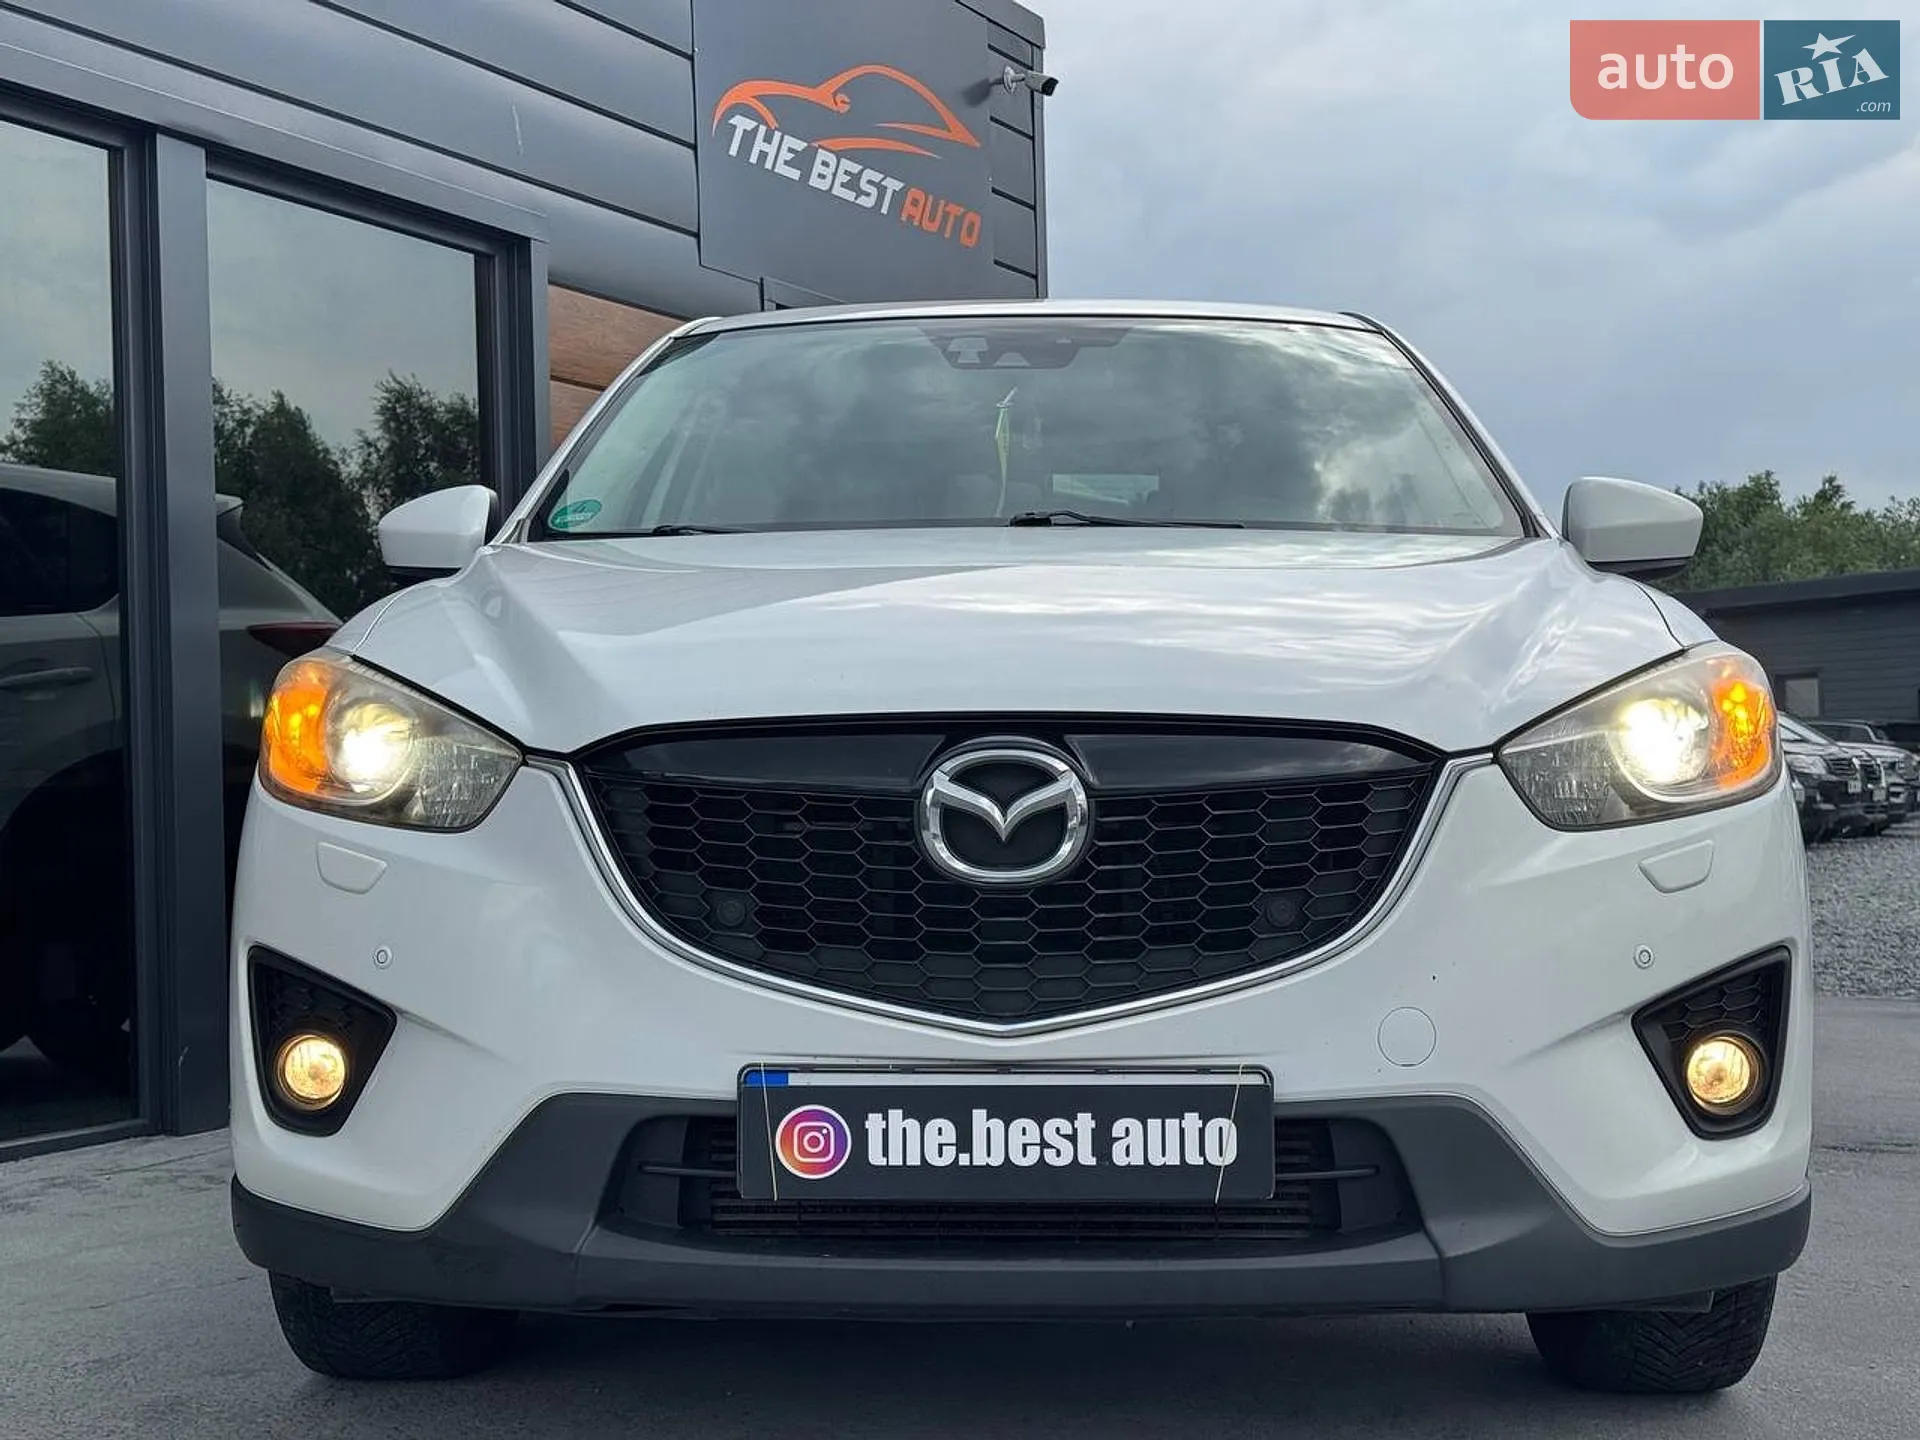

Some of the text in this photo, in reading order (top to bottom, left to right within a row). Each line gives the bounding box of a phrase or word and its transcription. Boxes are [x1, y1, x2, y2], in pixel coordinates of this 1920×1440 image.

[728, 114, 983, 249] THE BEST AUTO
[864, 1108, 1238, 1167] the.best auto
